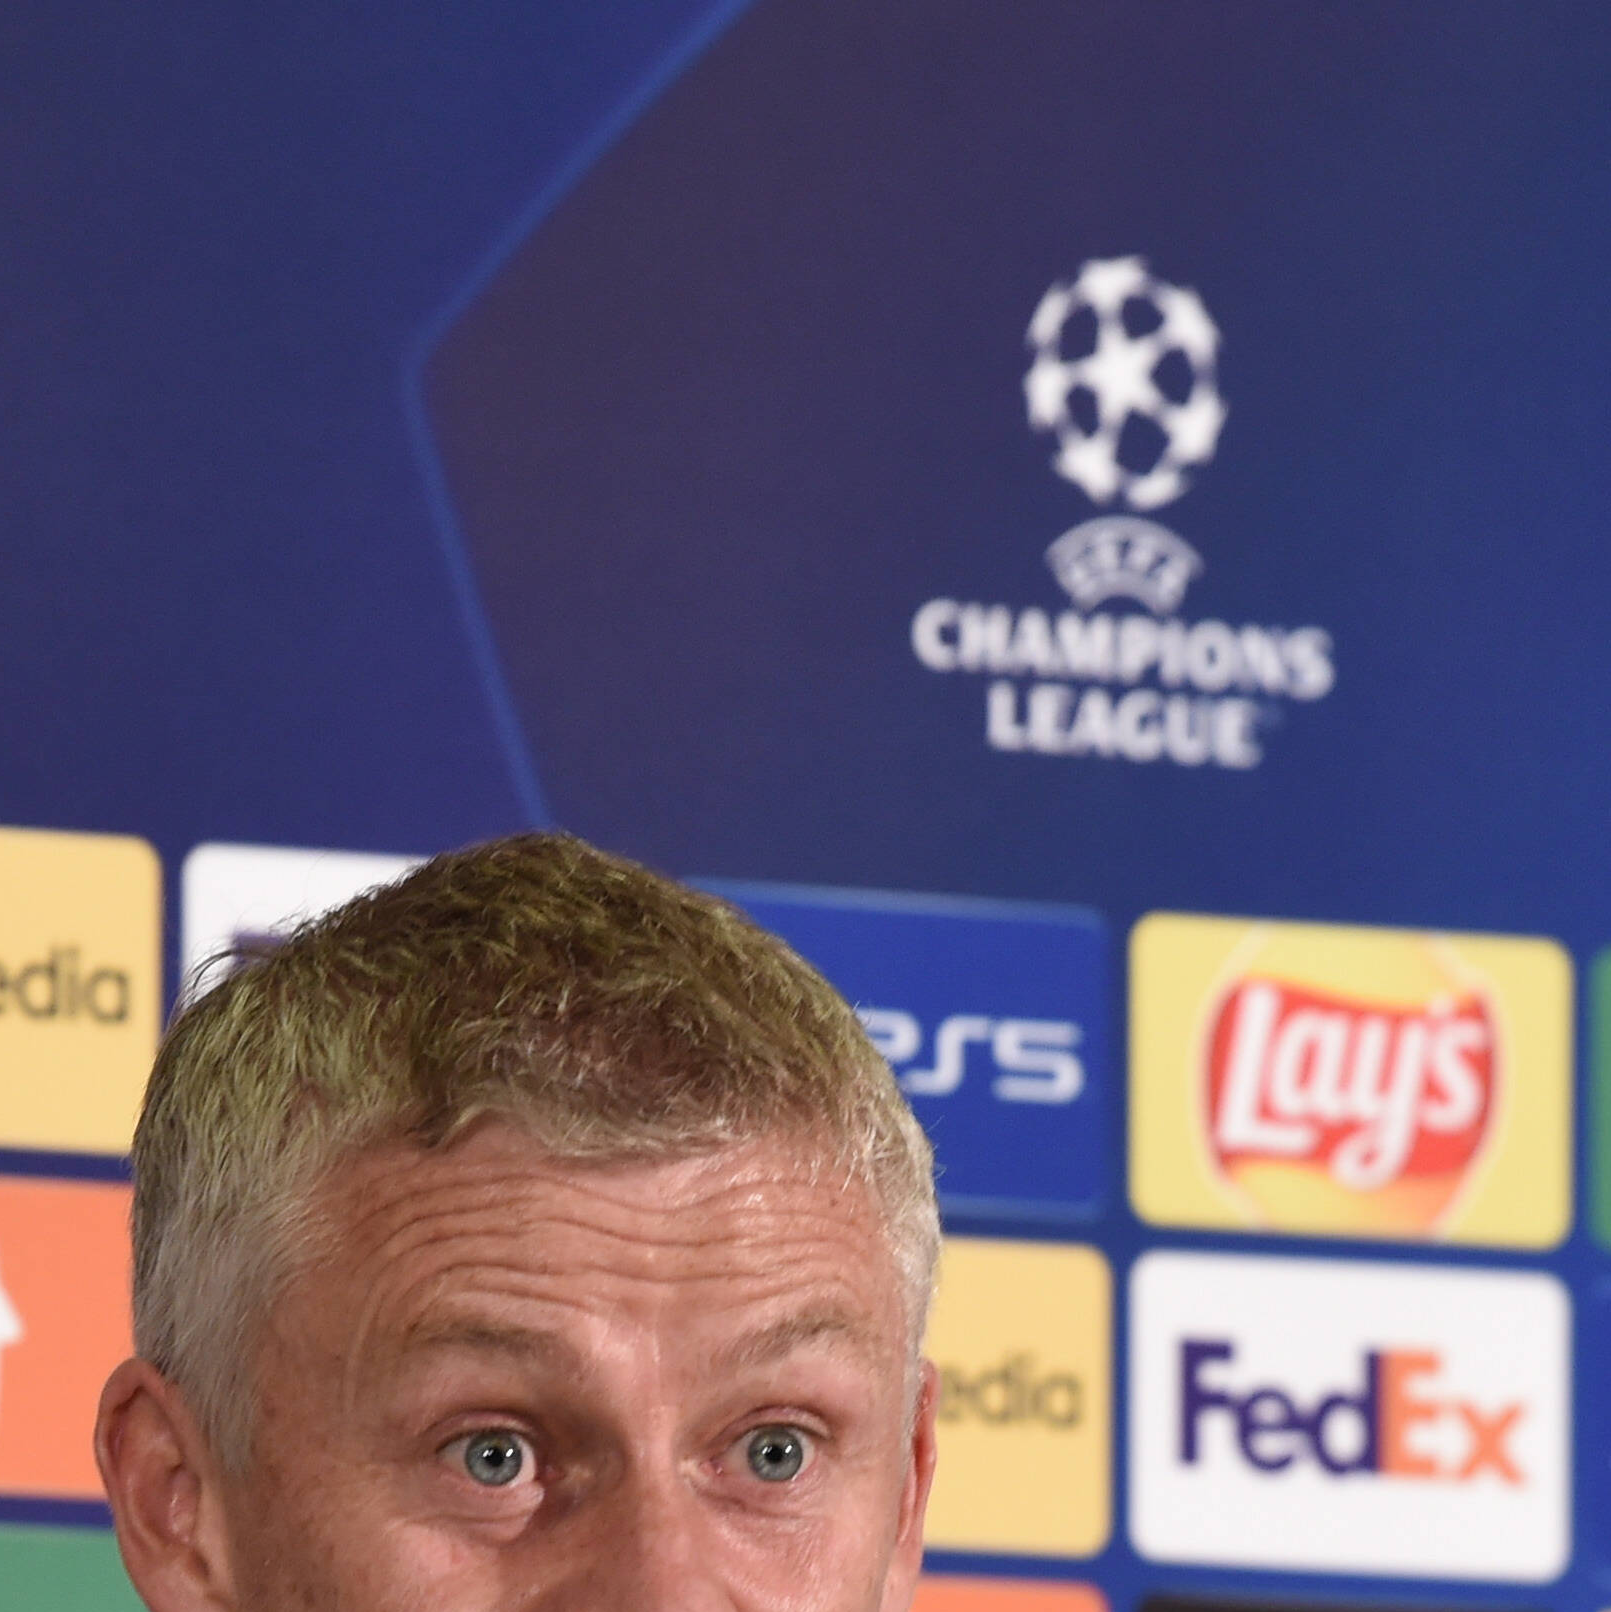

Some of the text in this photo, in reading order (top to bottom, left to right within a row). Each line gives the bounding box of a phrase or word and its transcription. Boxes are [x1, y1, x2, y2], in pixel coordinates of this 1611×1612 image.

[911, 598, 1334, 700] CHAMPIONS
[988, 680, 1261, 769] LEAGUE
[1220, 980, 1486, 1189] Lay's
[1176, 1336, 1524, 1488] FedEx
